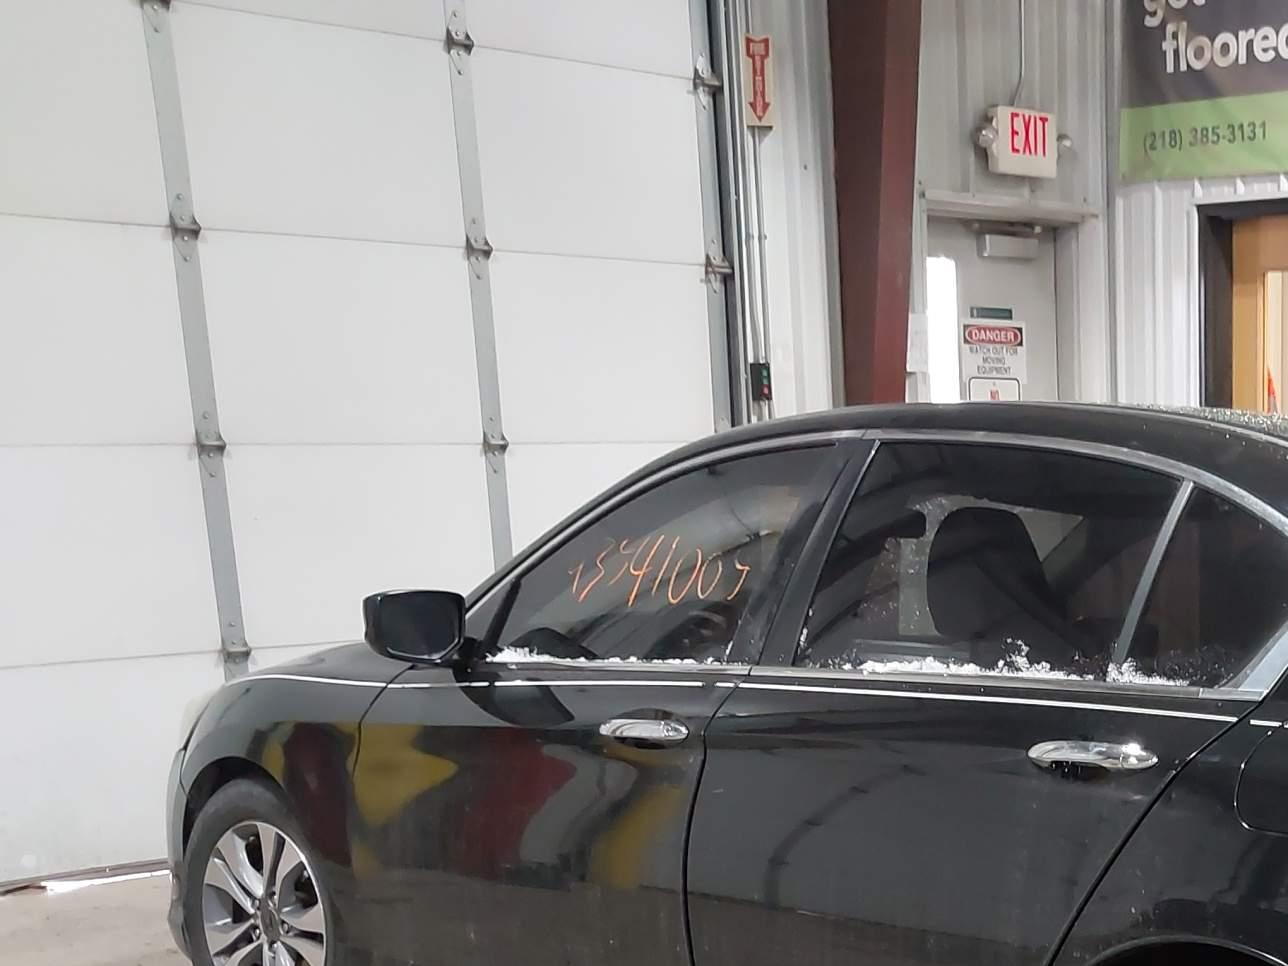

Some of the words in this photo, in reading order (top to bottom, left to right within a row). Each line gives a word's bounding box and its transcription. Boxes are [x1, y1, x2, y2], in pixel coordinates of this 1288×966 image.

[1011, 111, 1049, 158] EXIT
[1143, 129, 1183, 152] (218)
[1188, 121, 1268, 148] 385-3131
[971, 328, 1015, 343] DANGER
